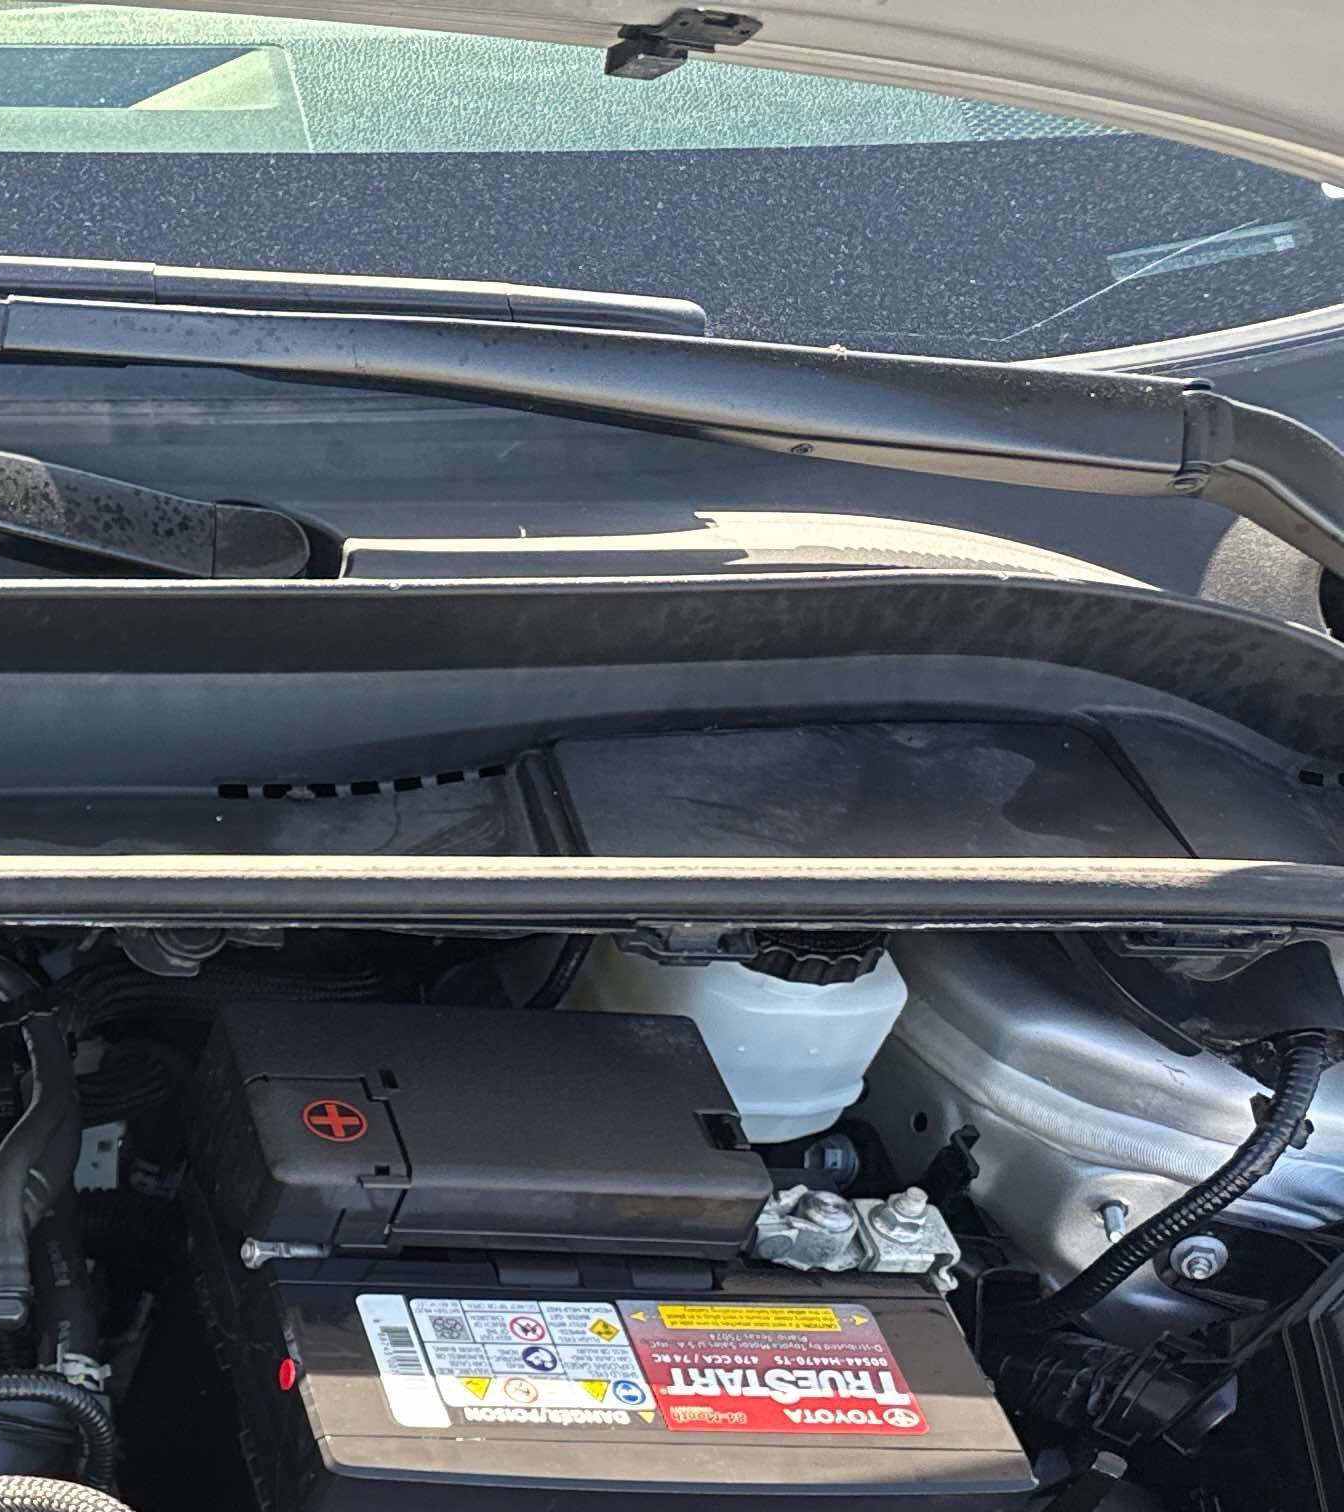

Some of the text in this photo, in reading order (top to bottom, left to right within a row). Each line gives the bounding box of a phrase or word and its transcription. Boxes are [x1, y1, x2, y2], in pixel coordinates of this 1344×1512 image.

[649, 1353, 671, 1362] RC
[671, 1353, 691, 1362] 74
[701, 1354, 732, 1363] CCA
[733, 1354, 759, 1363] 470
[782, 1407, 882, 1424] TOYOTA
